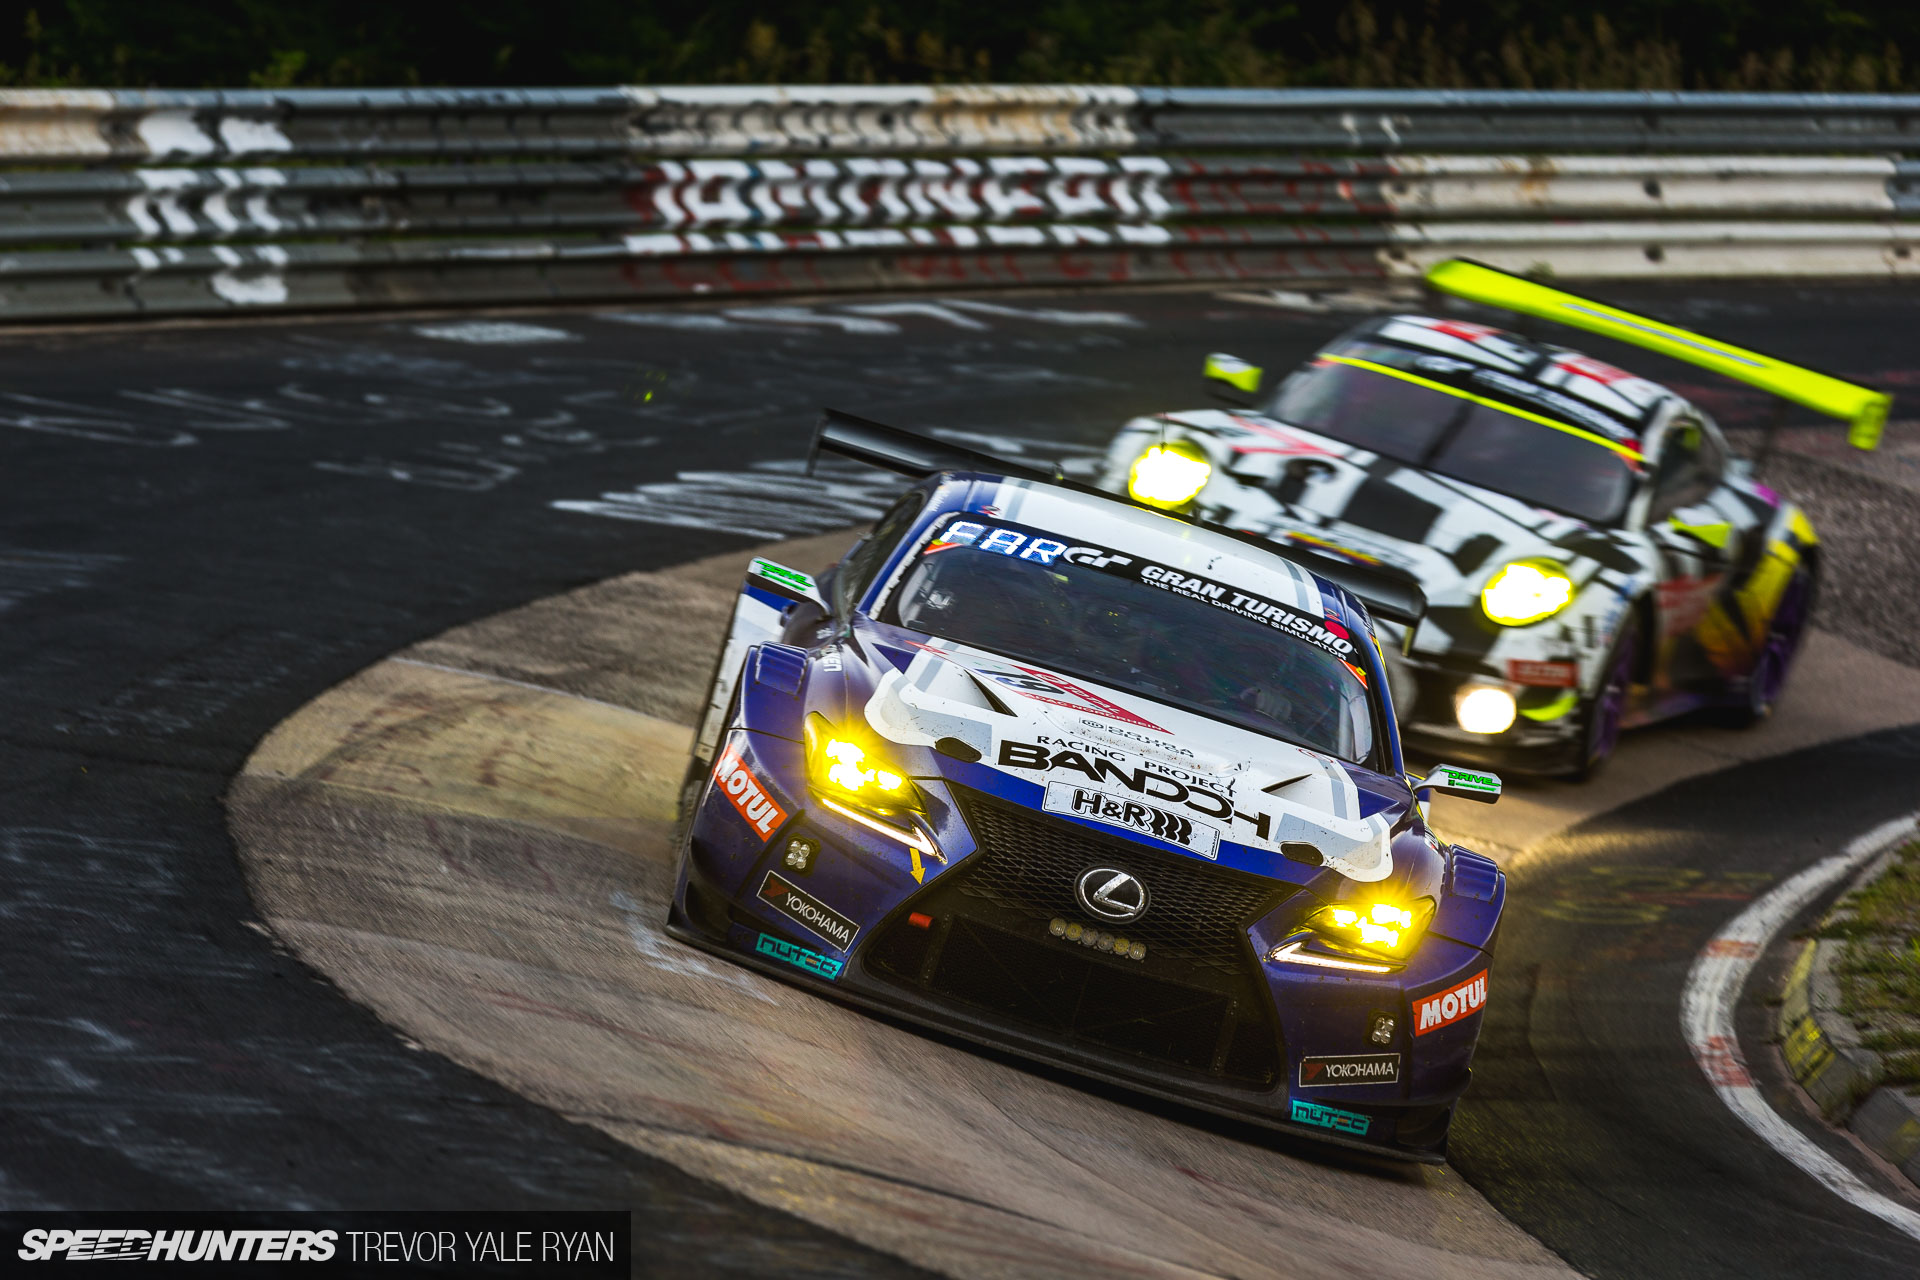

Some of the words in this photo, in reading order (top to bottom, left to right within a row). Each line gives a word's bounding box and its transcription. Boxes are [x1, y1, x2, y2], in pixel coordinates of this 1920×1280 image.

[940, 521, 1068, 563] FAR
[1140, 565, 1227, 600] GRAN
[1232, 592, 1354, 654] TURISMO
[1140, 577, 1169, 590] THE
[1172, 586, 1209, 604] REAL
[1211, 599, 1268, 625] DRIVING
[1270, 620, 1347, 661] SIMULATOR
[998, 740, 1271, 840] BANDOH
[1037, 735, 1126, 762] RACING
[1144, 761, 1237, 797] PROJECT
[1440, 768, 1501, 788] DRIVE
[716, 755, 779, 834] MOTUL
[1072, 789, 1148, 828] H&R
[785, 892, 850, 943] YOKOHAMA
[1419, 976, 1487, 1031] MOTUL
[1325, 1061, 1394, 1077] YOKOHAMA
